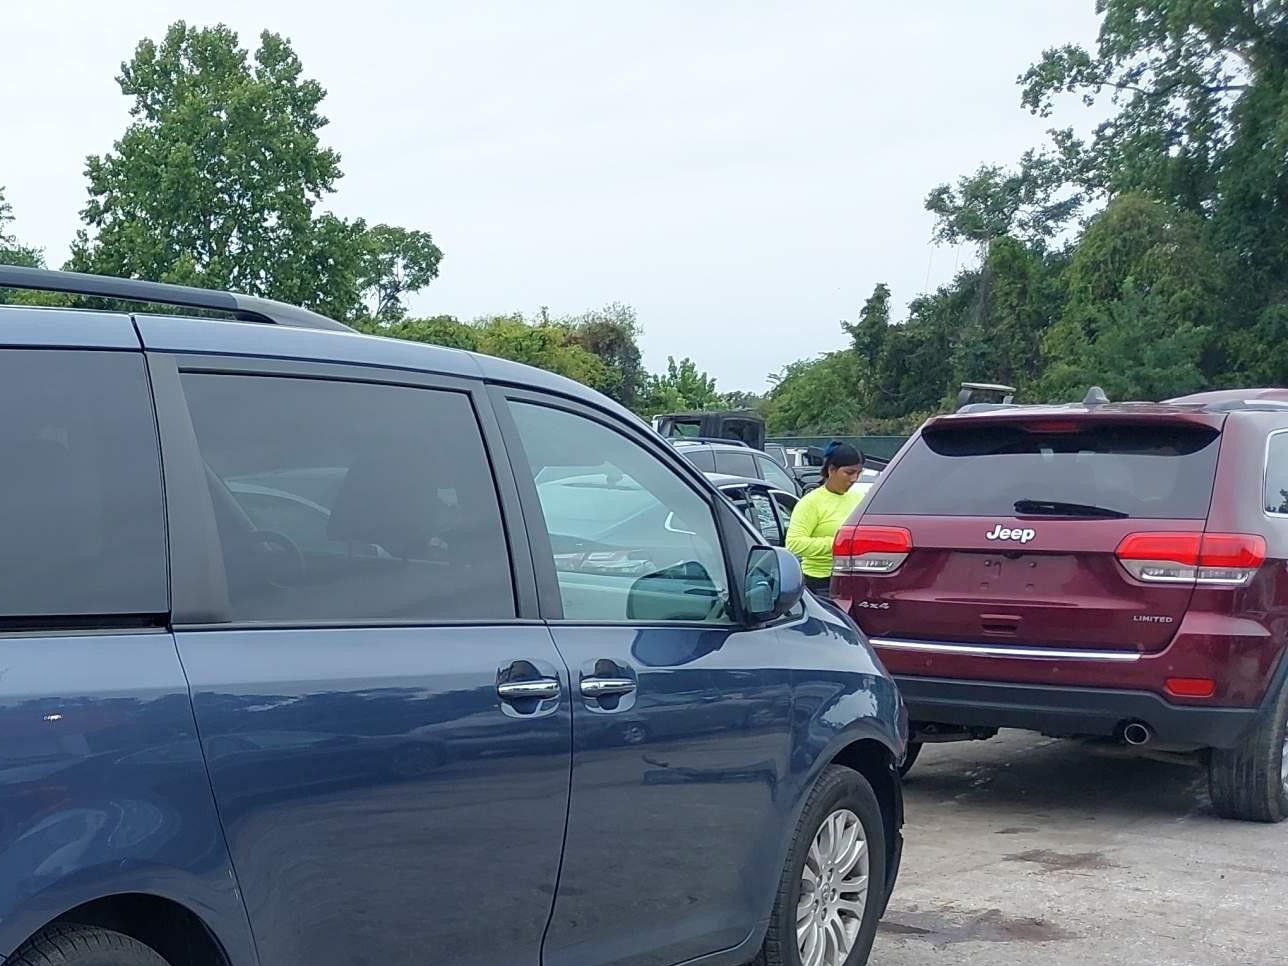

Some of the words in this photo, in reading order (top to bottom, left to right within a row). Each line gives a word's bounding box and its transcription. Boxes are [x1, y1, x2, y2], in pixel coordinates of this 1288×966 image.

[986, 524, 1035, 543] Jeep
[858, 601, 889, 609] 4x4
[1133, 615, 1173, 623] LIMITED
